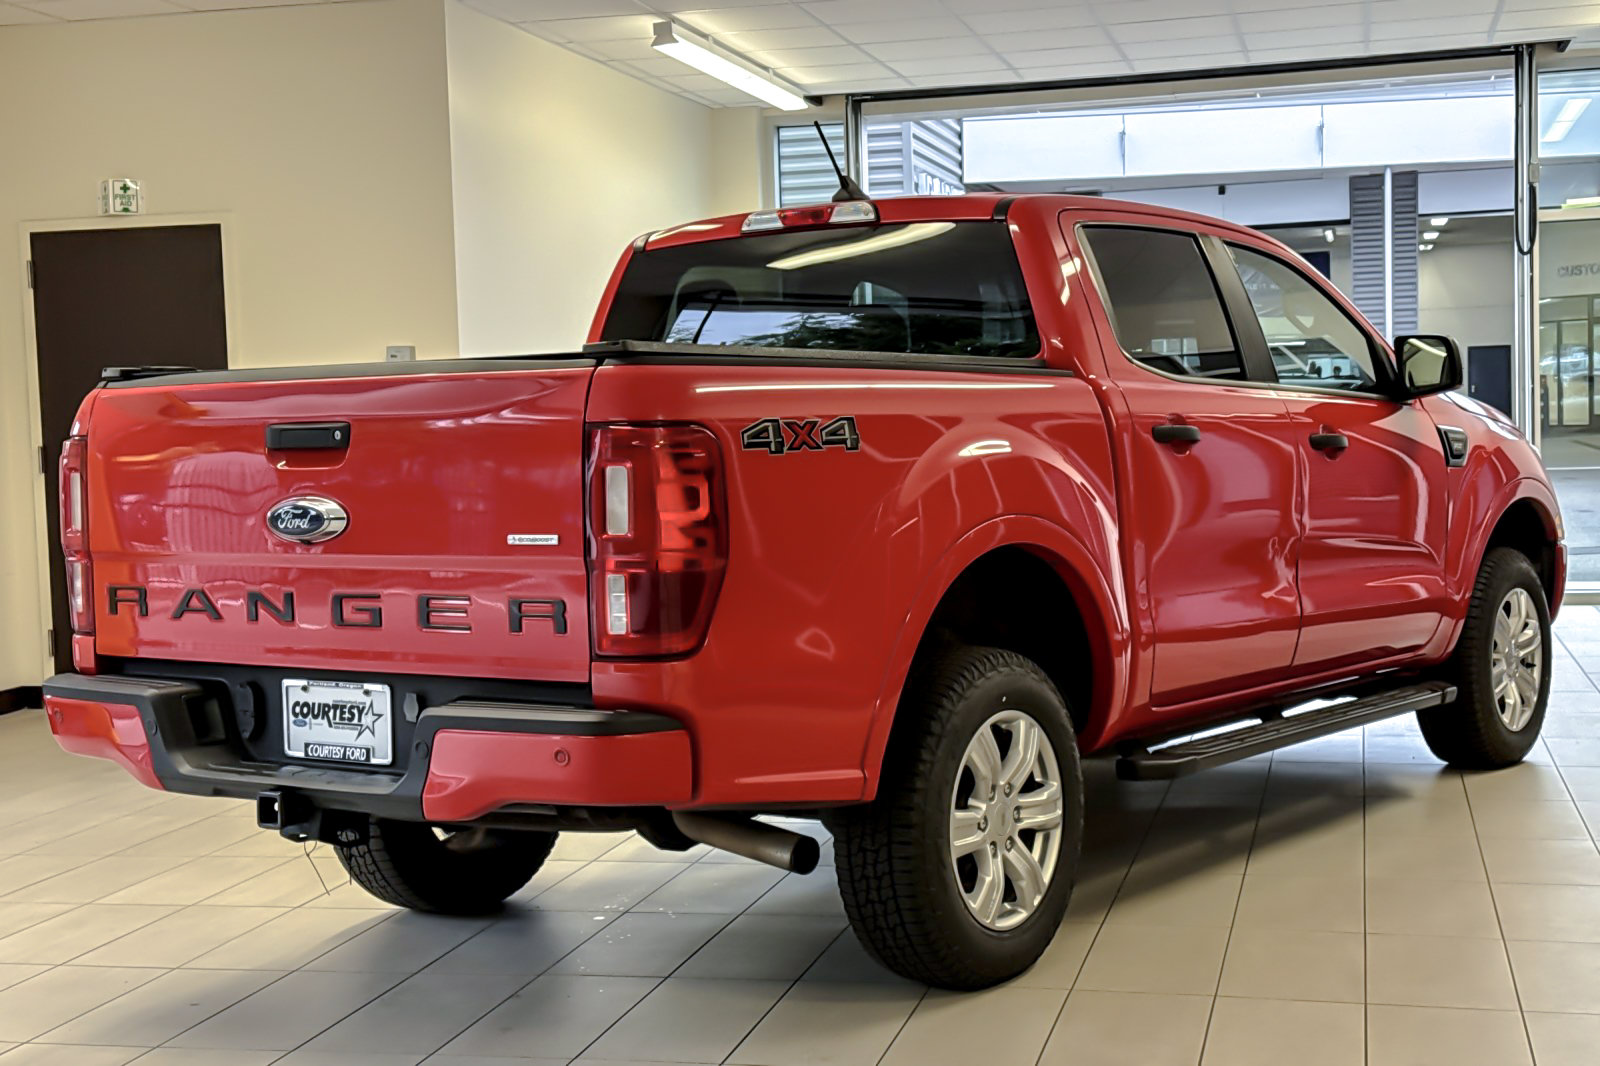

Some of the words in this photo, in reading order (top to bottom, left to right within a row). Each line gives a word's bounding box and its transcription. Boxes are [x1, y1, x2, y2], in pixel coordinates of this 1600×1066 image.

[114, 193, 136, 201] FIRST
[274, 505, 317, 529] Ford
[107, 585, 568, 635] RANGER
[292, 701, 366, 728] COURTESY
[308, 744, 344, 759] COURTESY
[345, 746, 367, 761] FORD
